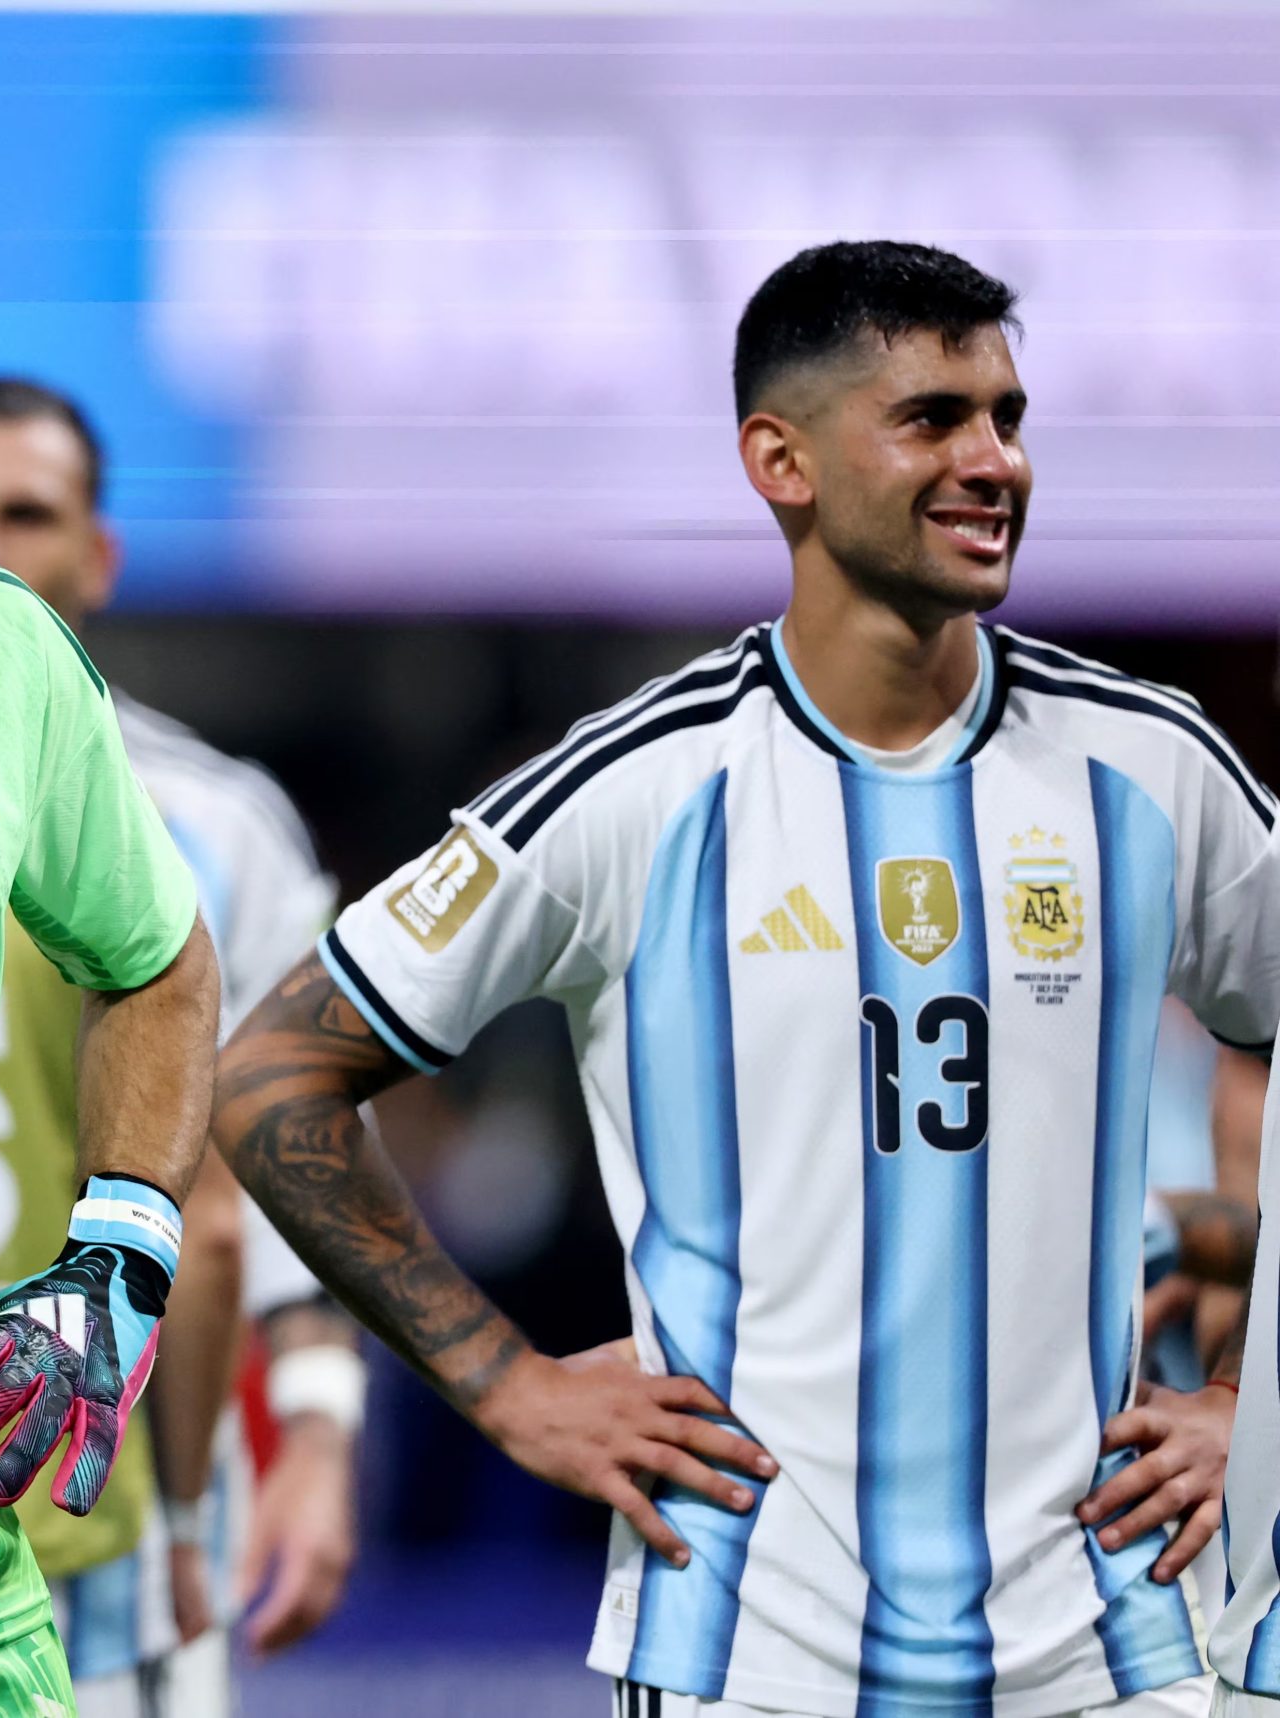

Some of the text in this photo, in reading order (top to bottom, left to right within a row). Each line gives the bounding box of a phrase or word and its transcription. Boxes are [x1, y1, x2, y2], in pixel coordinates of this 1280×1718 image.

[903, 924, 941, 940] FIFA
[860, 994, 990, 1155] 13
[132, 1209, 152, 1221] AVA
